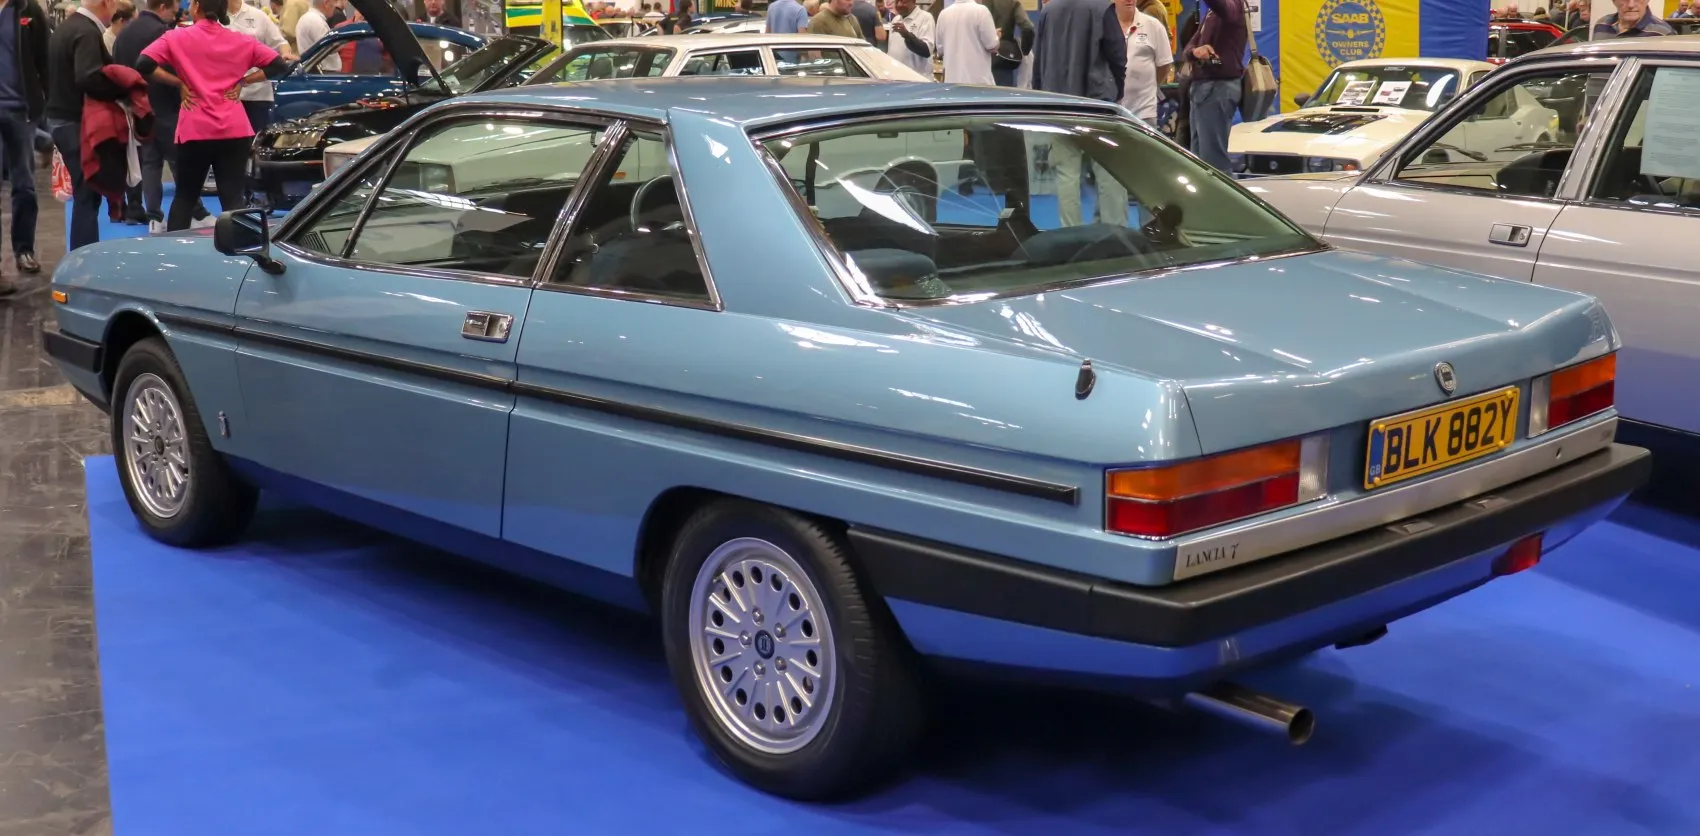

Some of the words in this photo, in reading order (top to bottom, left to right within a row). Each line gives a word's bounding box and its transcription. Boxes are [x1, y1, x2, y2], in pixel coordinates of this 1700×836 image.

[1331, 13, 1369, 24] SAAB
[1340, 48, 1363, 56] CLUB
[1384, 417, 1441, 475] BLK
[1447, 398, 1514, 457] 882Y
[1369, 464, 1381, 476] GB
[1186, 546, 1226, 568] LANCIA
